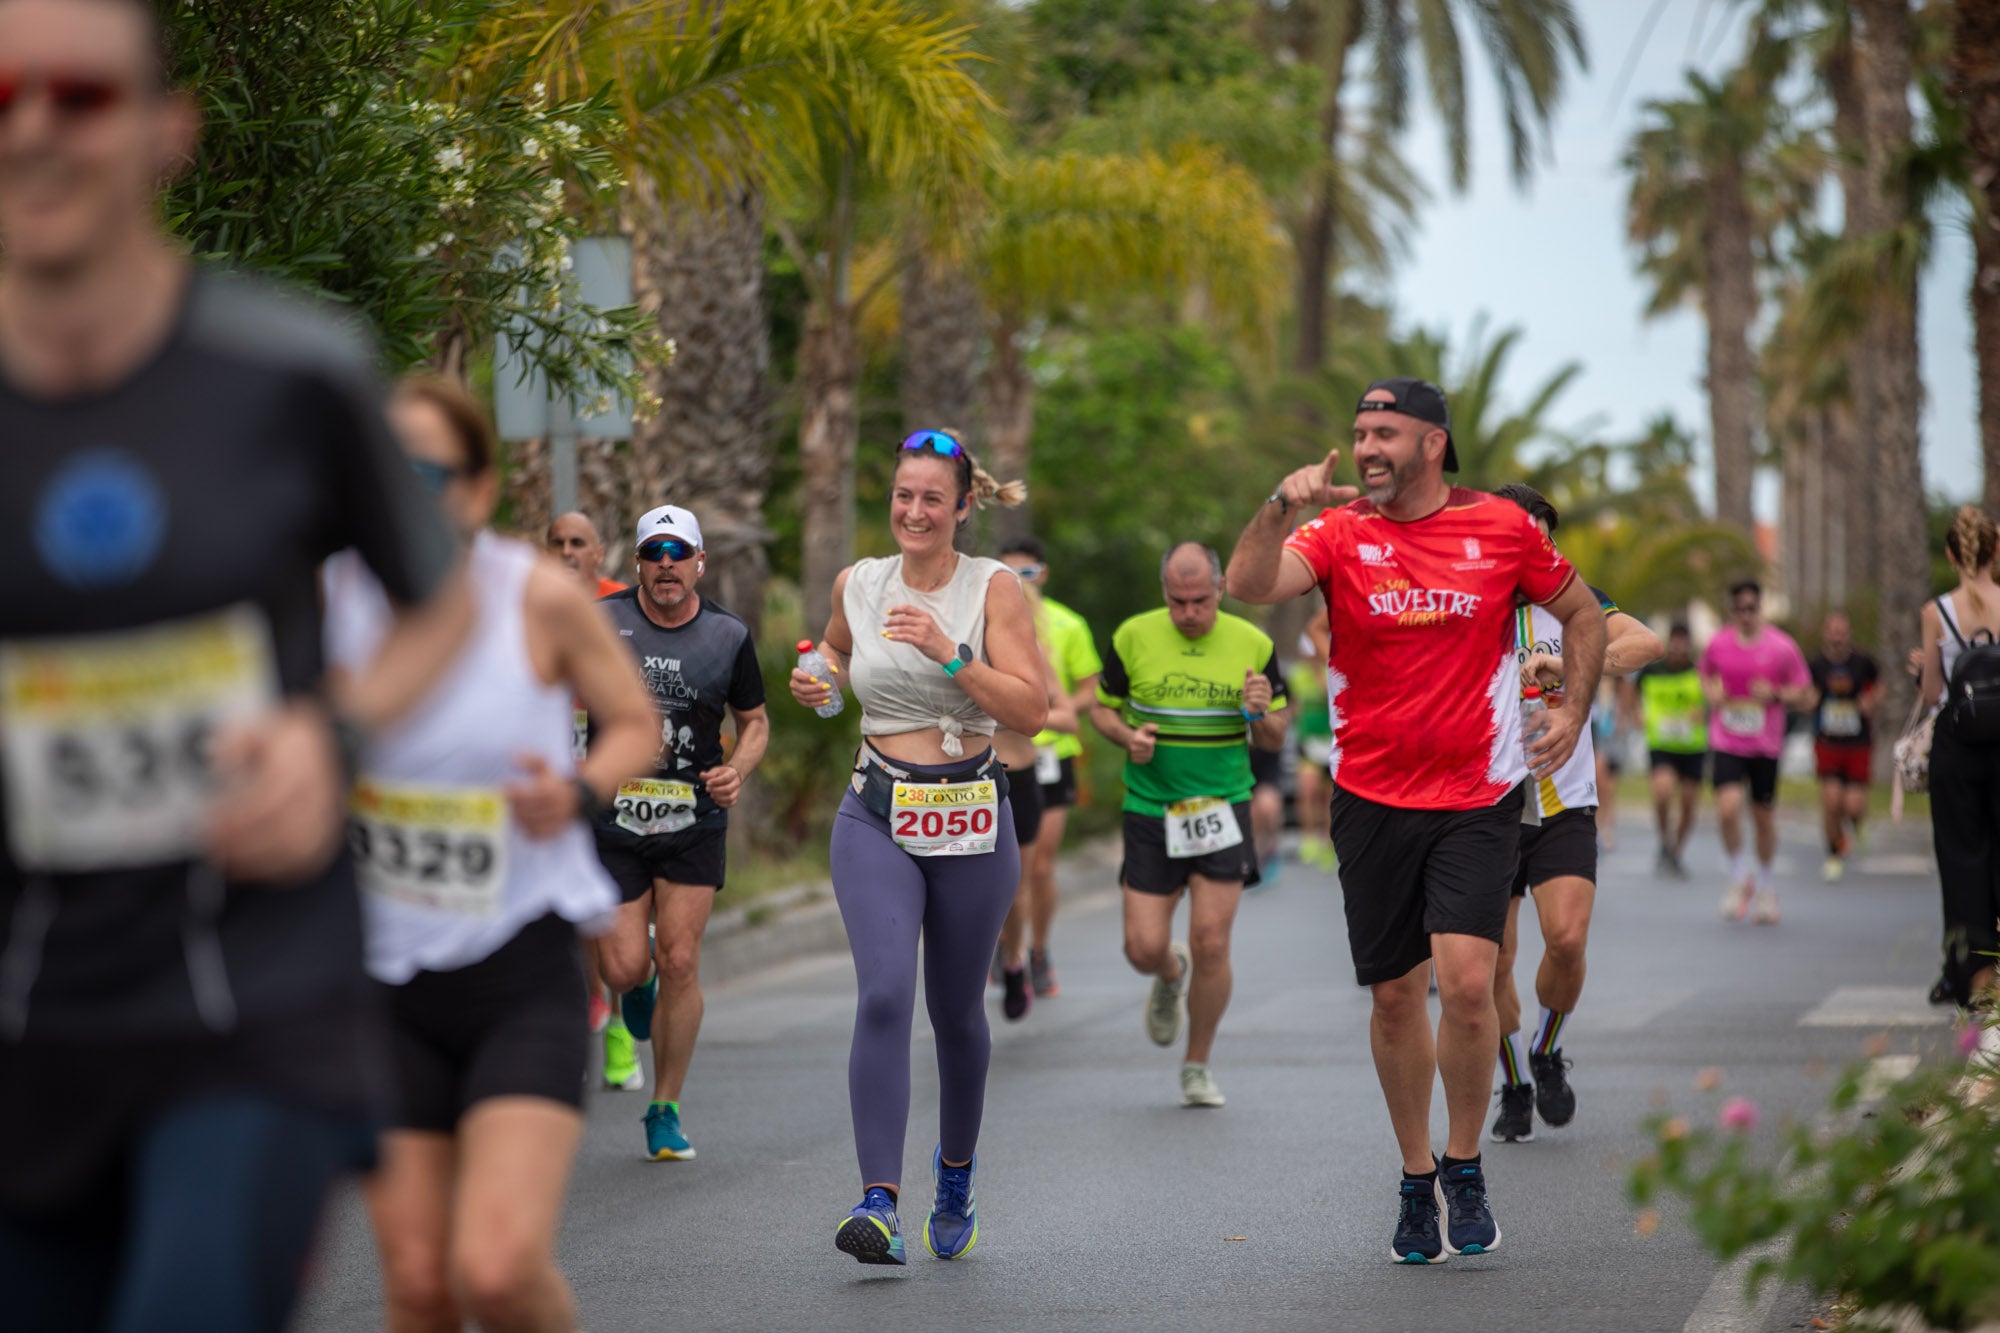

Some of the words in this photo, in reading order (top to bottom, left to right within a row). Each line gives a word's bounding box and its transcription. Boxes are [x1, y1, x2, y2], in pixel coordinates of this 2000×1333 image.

[1368, 587, 1481, 618] SILVESTRE
[644, 656, 681, 672] XVIII
[639, 668, 685, 686] MEDIA
[639, 681, 698, 700] ARATÓN
[908, 789, 925, 802] 38
[925, 791, 975, 803] FONDO
[896, 808, 992, 838] 2050
[1182, 813, 1222, 840] 165
